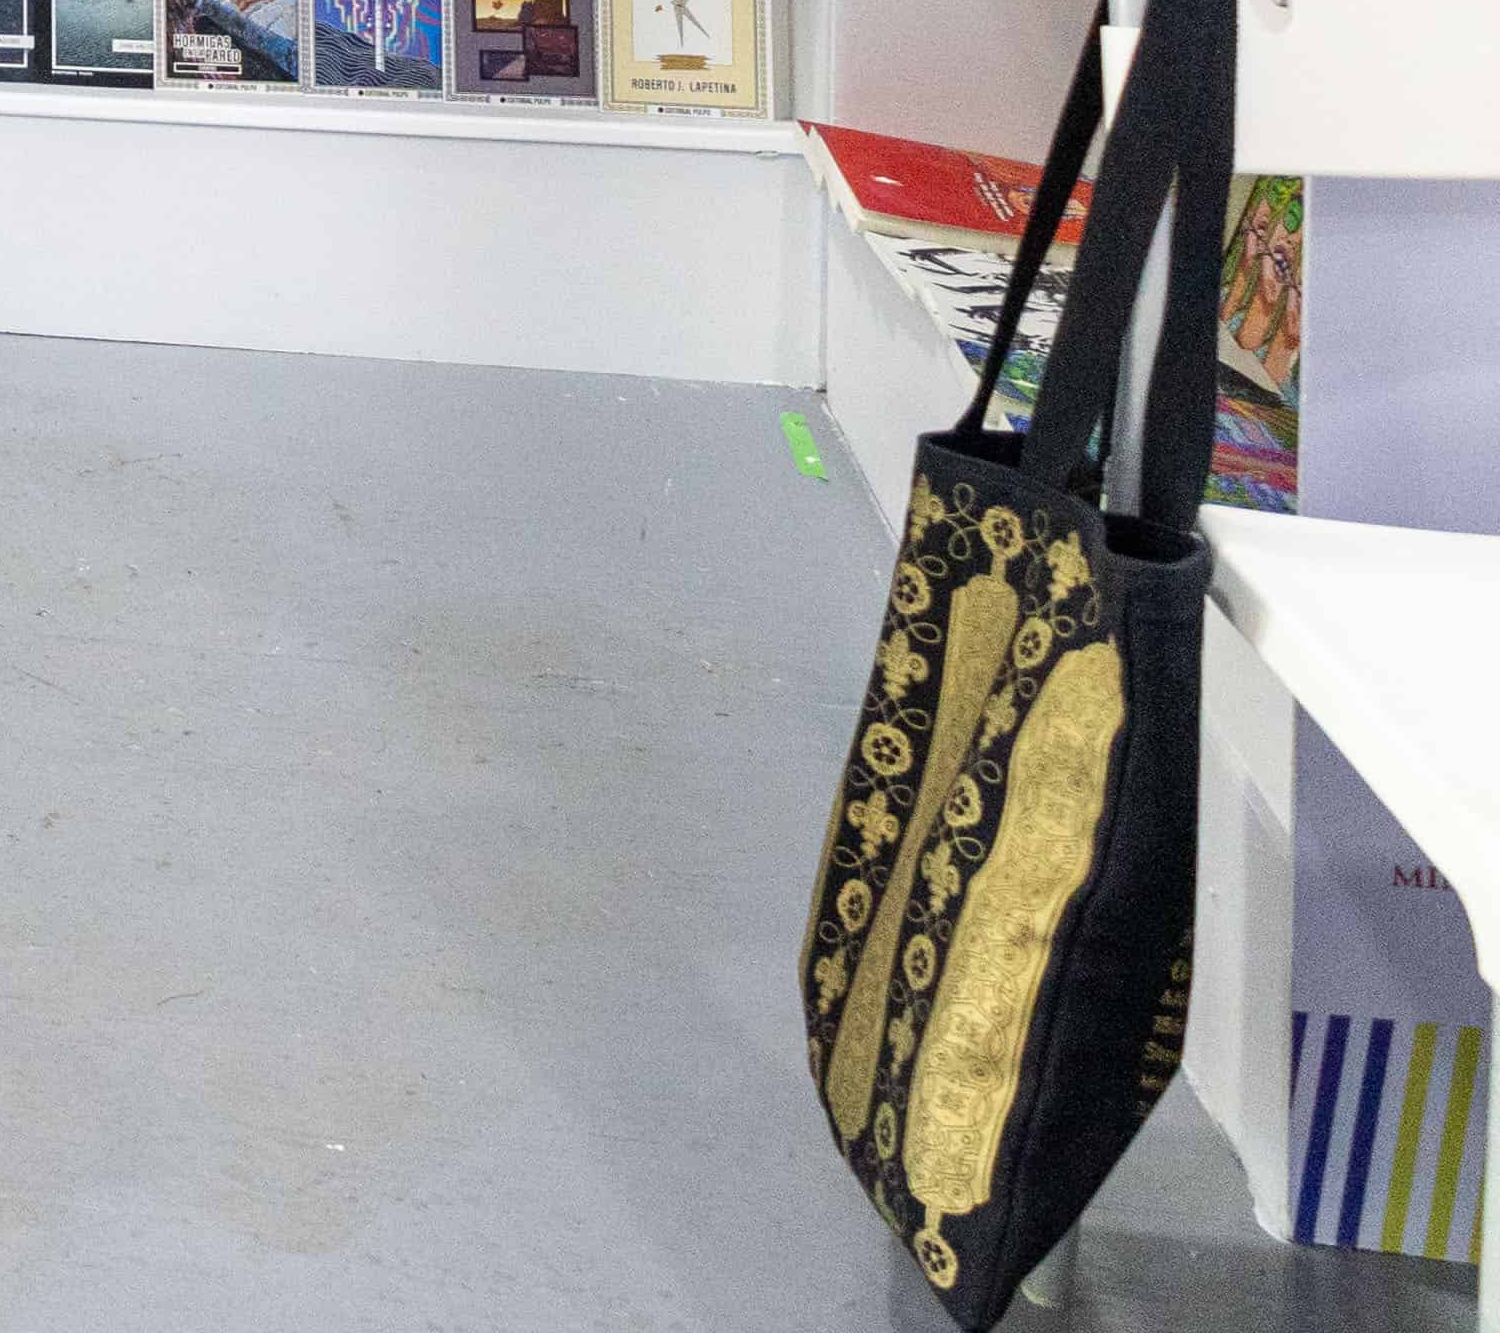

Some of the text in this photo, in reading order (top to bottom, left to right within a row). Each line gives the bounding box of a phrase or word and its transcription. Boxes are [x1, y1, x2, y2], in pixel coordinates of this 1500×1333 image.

[173, 34, 232, 49] HORMIGAS
[631, 78, 676, 91] ROBERTO
[689, 81, 737, 93] LAPETINA
